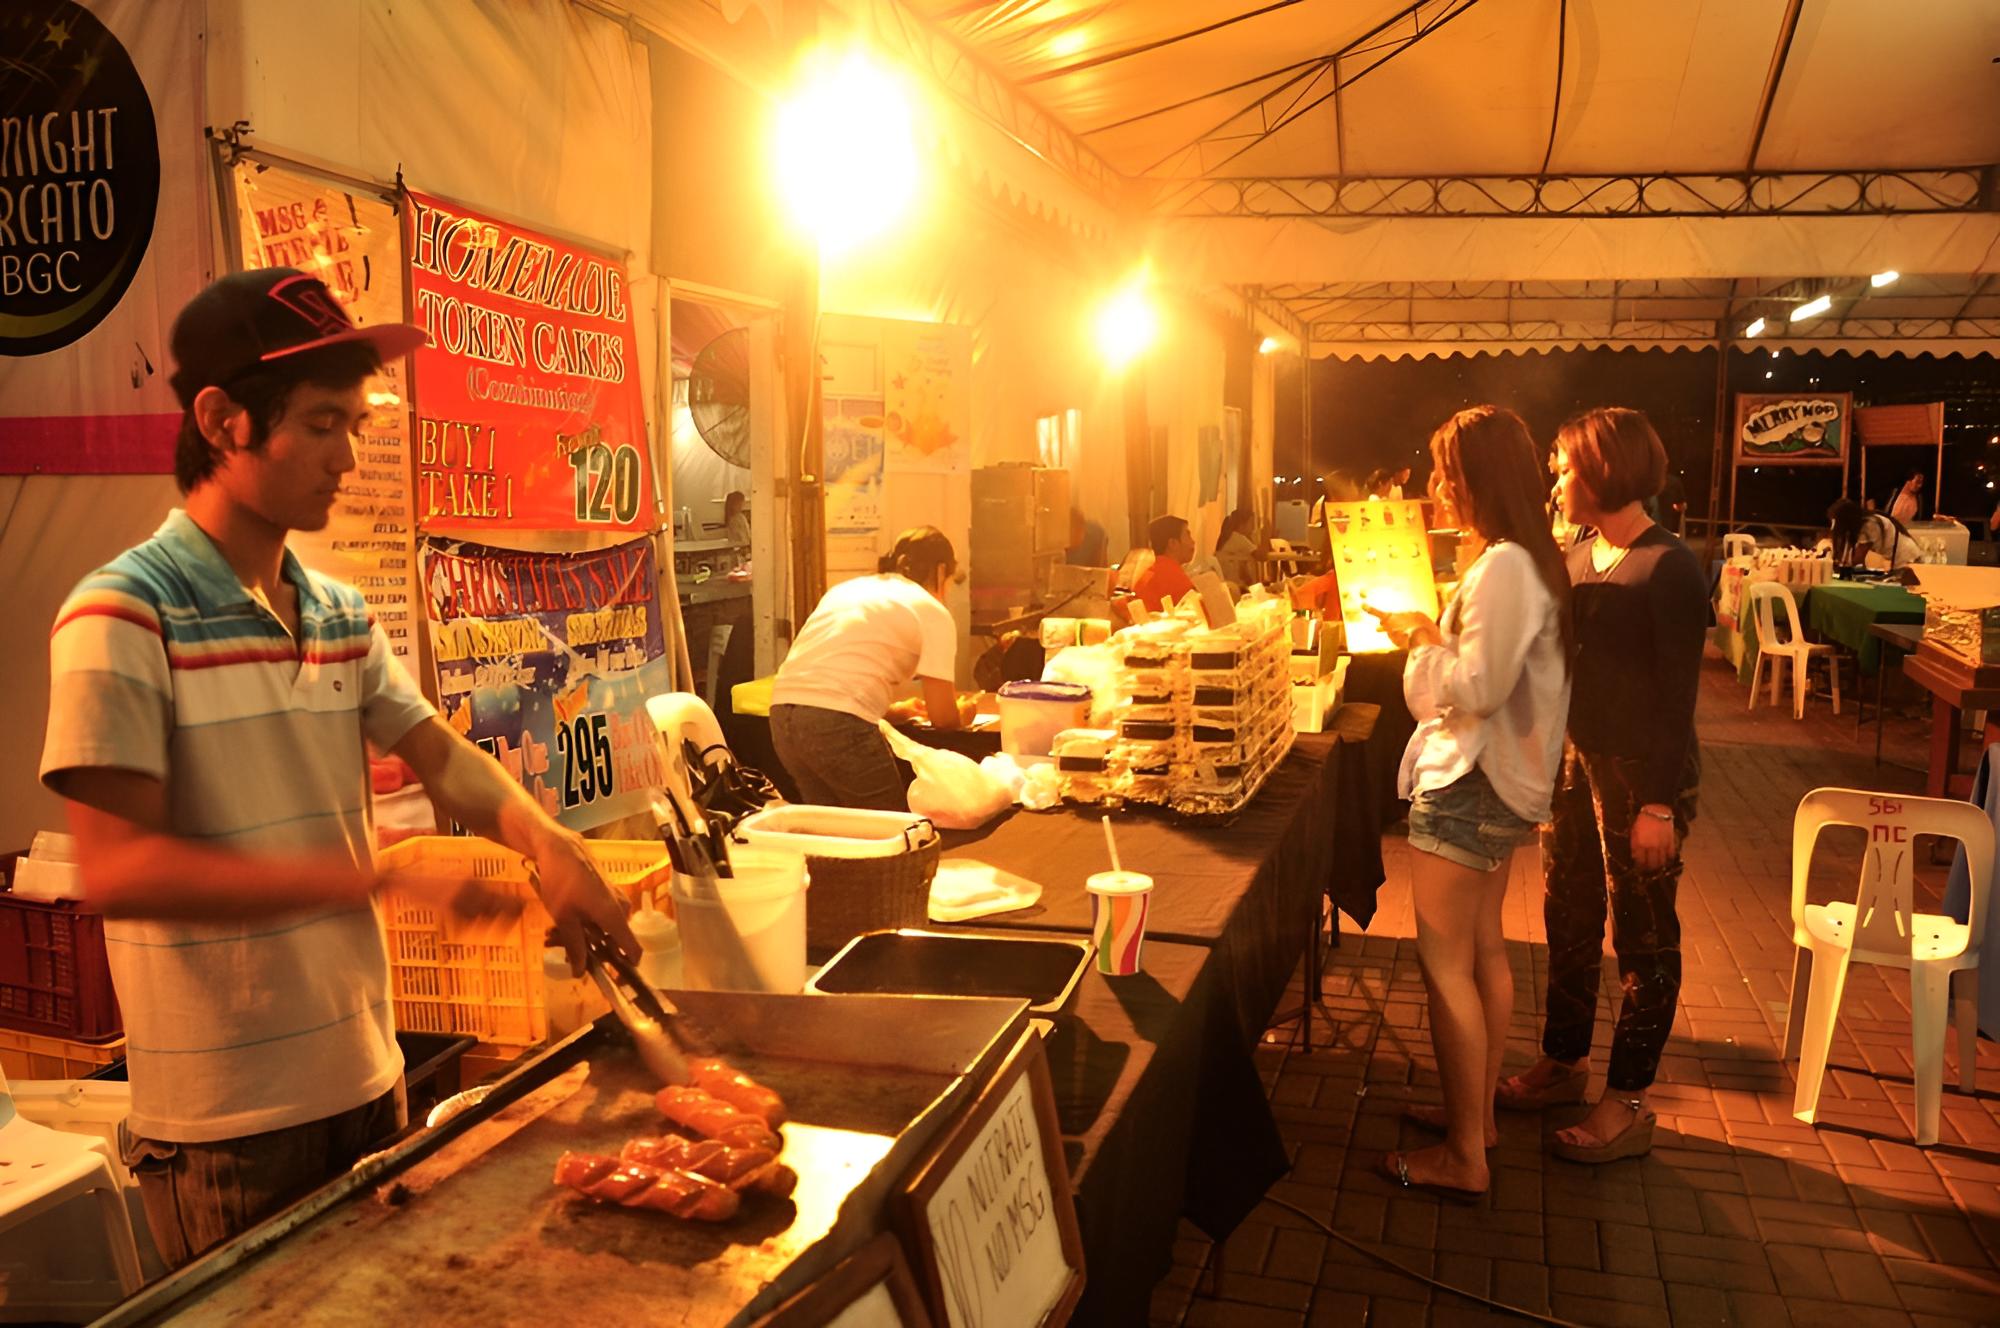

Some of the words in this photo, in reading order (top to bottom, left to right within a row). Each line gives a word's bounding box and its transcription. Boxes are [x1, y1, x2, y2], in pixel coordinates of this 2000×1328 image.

[256, 202, 308, 239] MSG
[411, 203, 627, 323] HOMEMADE
[2, 250, 82, 296] BGC
[418, 288, 527, 368] TOKEN
[531, 321, 626, 384] CAKES
[420, 419, 480, 468] BUY
[568, 442, 642, 525] 120
[421, 471, 498, 518] TAKE
[557, 711, 614, 810] 295
[966, 1095, 1032, 1224] NITRATE
[985, 1220, 1011, 1295] NO
[1006, 1160, 1046, 1254] MSG
